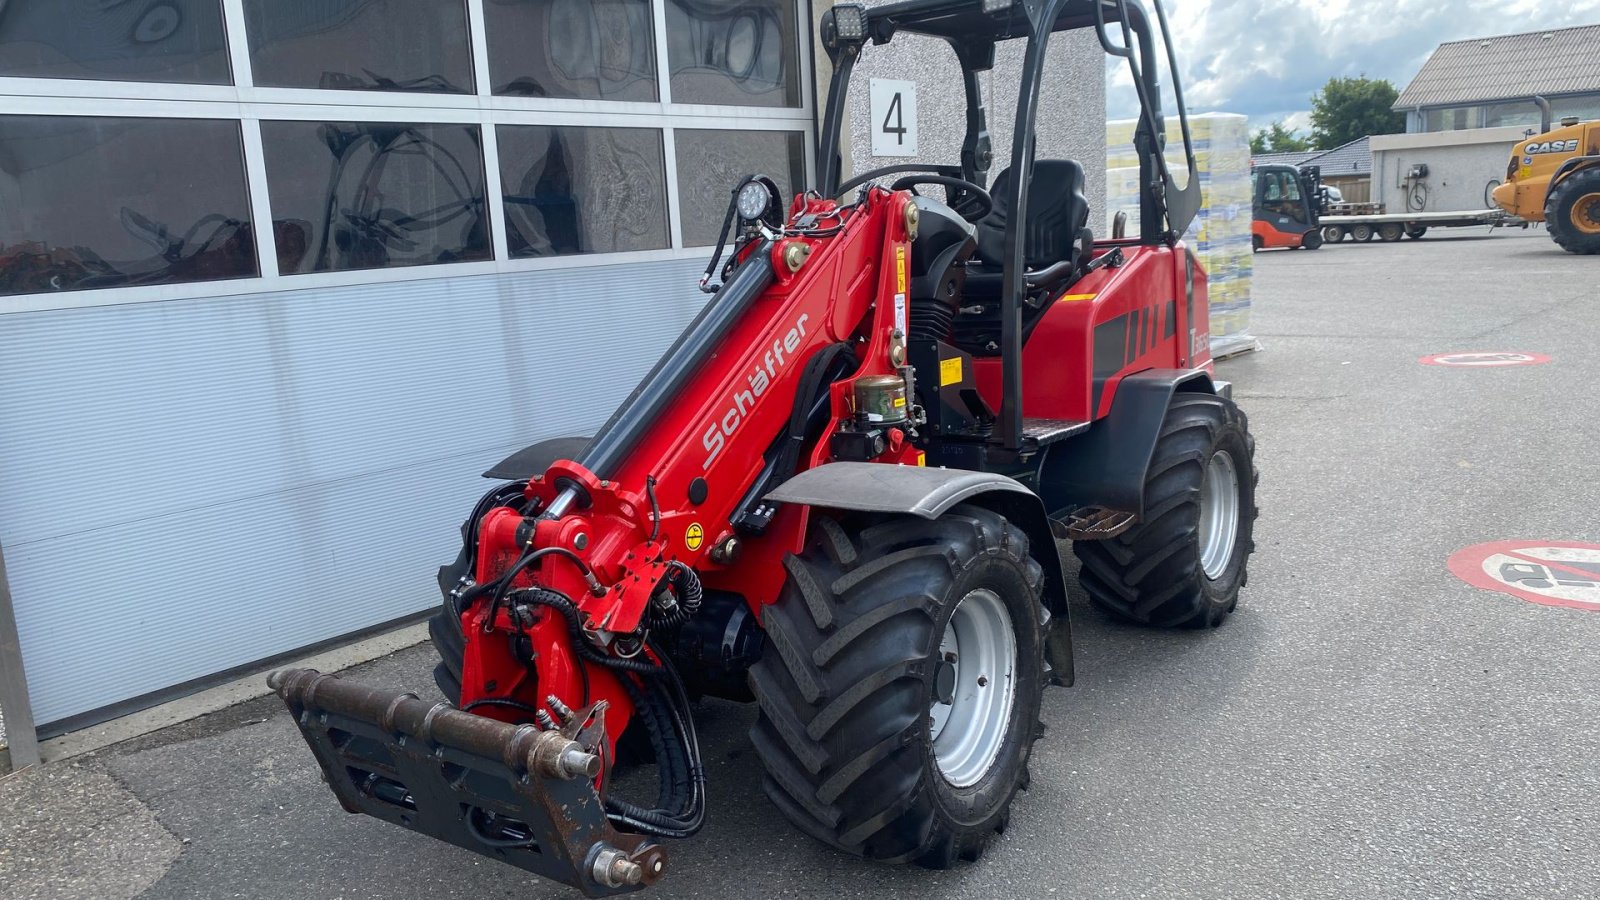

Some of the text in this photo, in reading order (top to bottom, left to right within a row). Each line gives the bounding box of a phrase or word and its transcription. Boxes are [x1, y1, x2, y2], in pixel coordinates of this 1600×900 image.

[883, 92, 907, 145] 4
[1525, 139, 1578, 154] CASE
[703, 313, 808, 471] Schäffer
